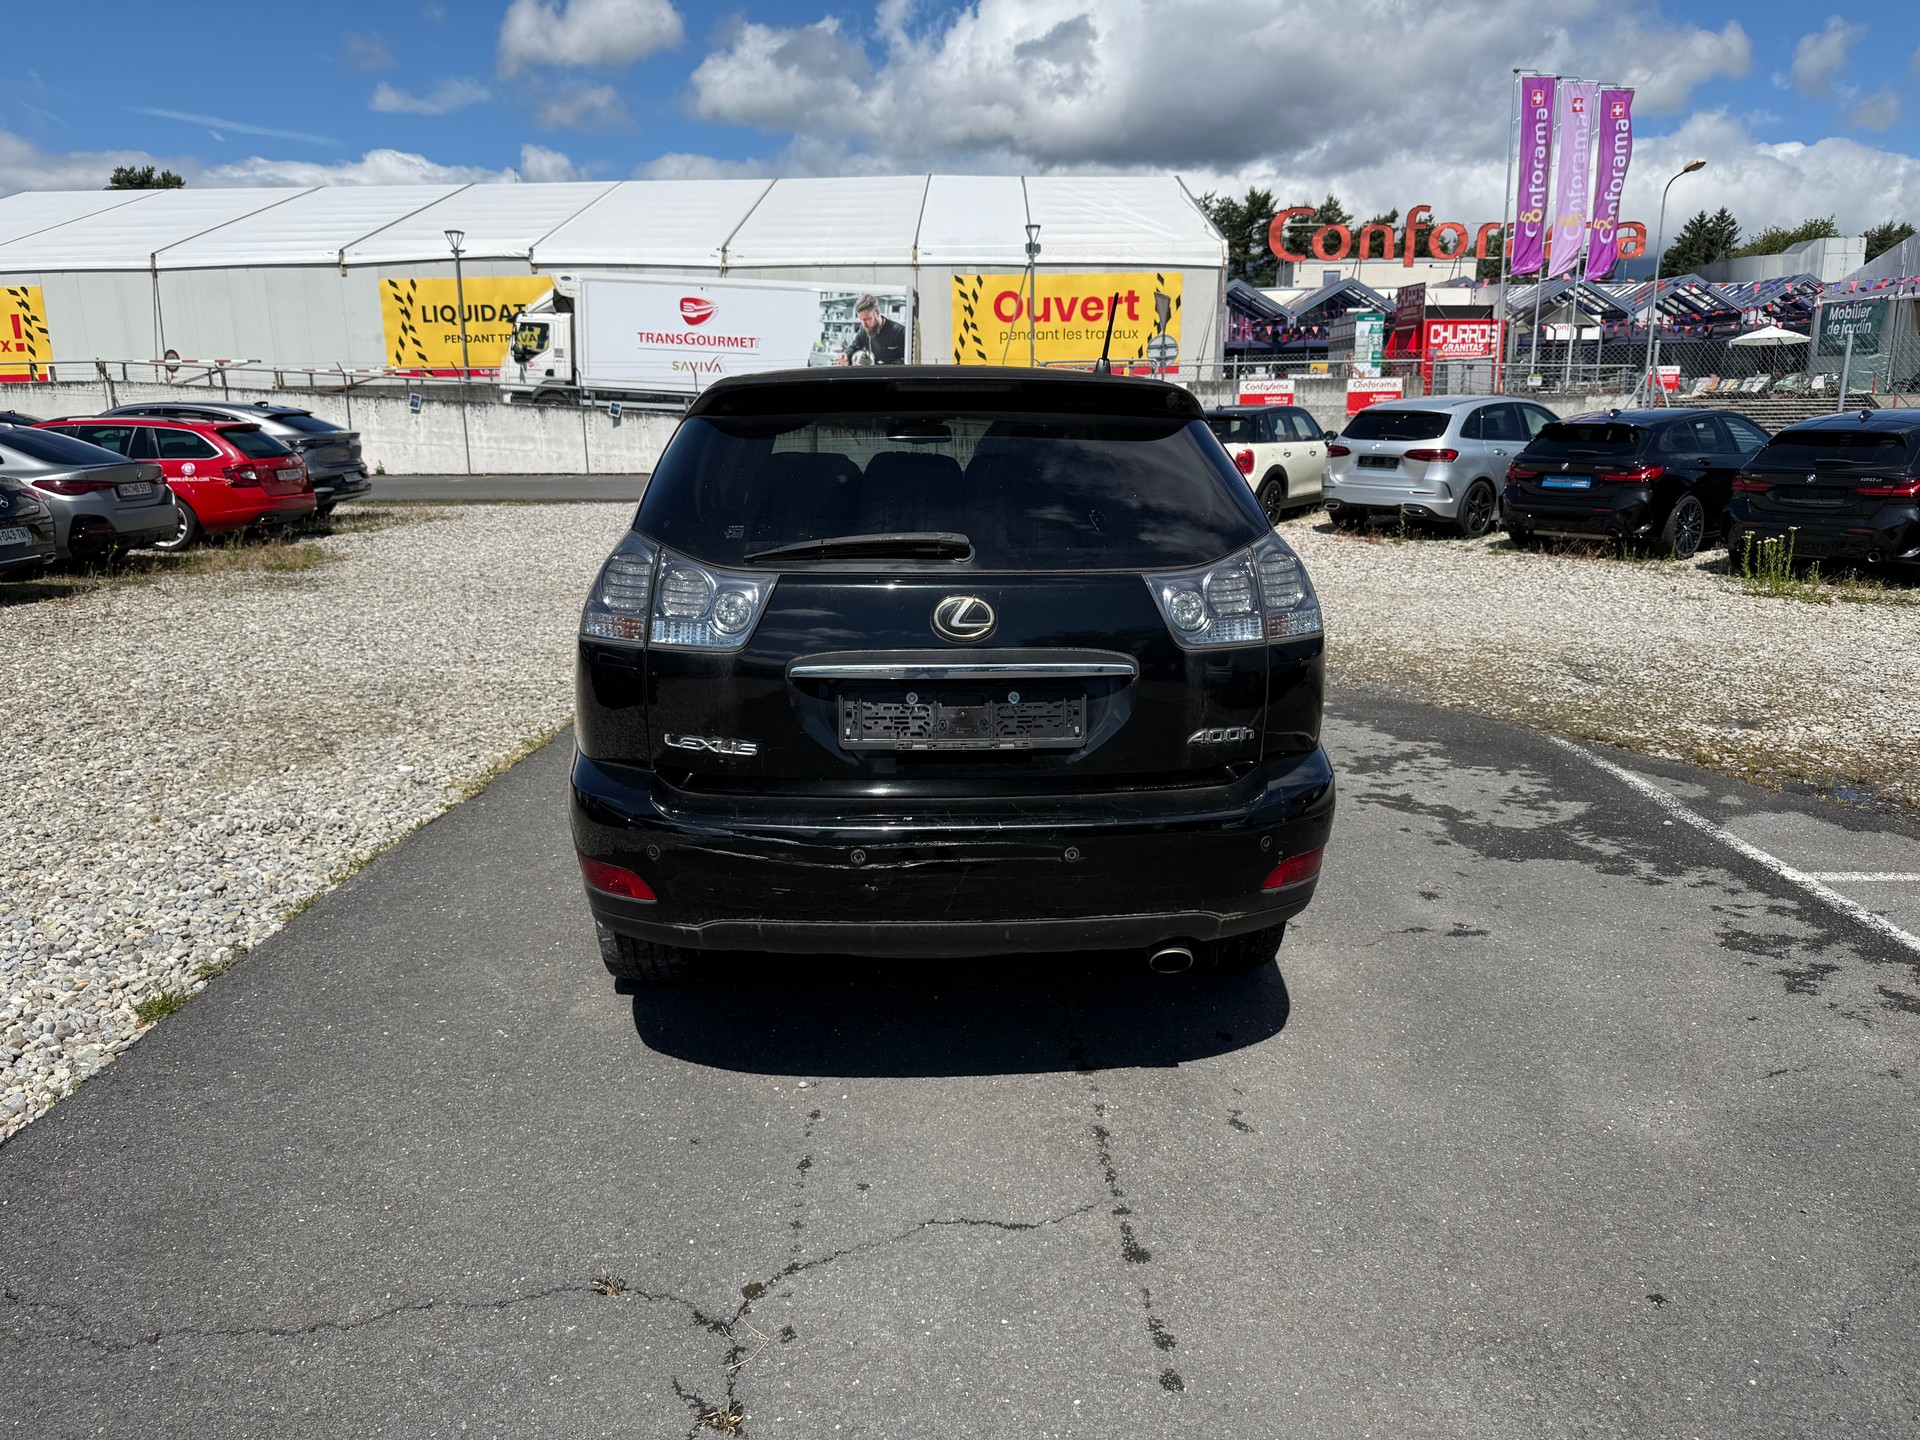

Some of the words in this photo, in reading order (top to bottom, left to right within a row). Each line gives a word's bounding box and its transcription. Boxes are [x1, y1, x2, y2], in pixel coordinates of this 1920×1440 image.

[1268, 204, 1647, 268] Confora
[993, 289, 1140, 323] Ouvert
[1829, 304, 1872, 320] Mobilier
[1063, 328, 1082, 340] les
[1430, 324, 1498, 344] CHURROS
[1827, 321, 1840, 335] de
[1841, 319, 1872, 339] jardin
[444, 334, 495, 344] PENDANT
[1442, 343, 1484, 352] GRANITAS
[672, 355, 723, 373] SAVIVA
[664, 733, 758, 756] LEXUS
[1188, 726, 1254, 745] 400h
